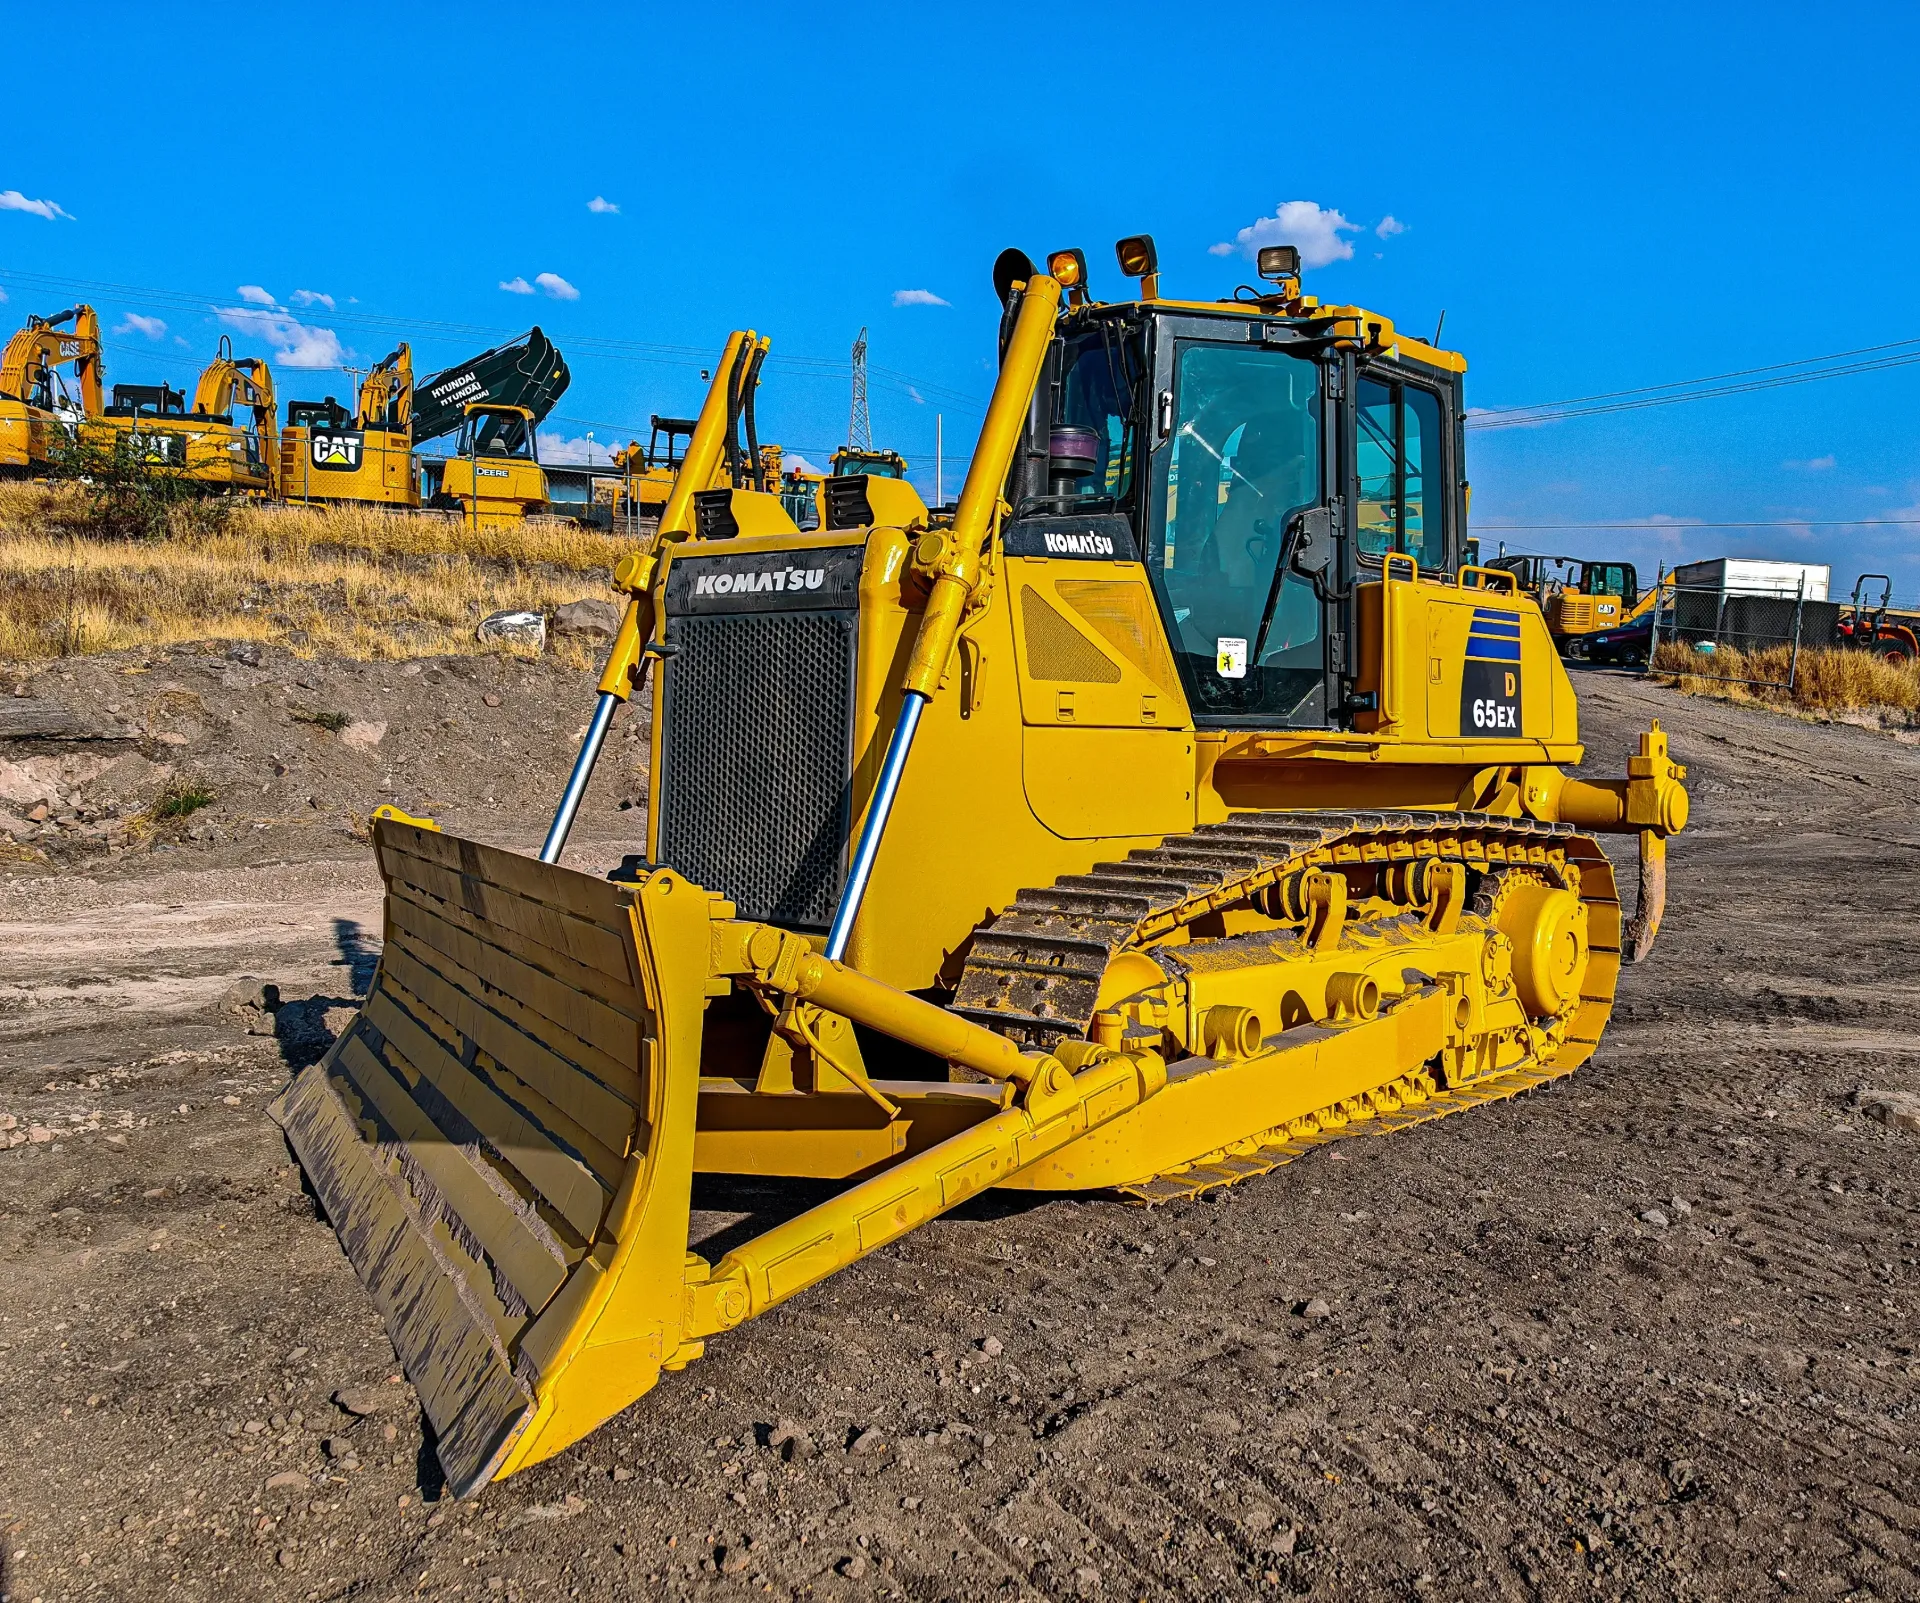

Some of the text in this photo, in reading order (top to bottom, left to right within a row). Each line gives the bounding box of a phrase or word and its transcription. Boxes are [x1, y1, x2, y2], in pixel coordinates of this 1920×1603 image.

[60, 341, 80, 356] CASE
[431, 371, 476, 399] HYUNDAI
[440, 381, 482, 406] HYUNDAI
[314, 435, 359, 465] CAT
[476, 467, 509, 477] DEERE
[1043, 530, 1114, 555] KOMATSU
[695, 566, 825, 595] KOMATSU
[1597, 604, 1614, 614] CAT
[1504, 671, 1516, 697] D
[1472, 698, 1517, 729] 65EX
